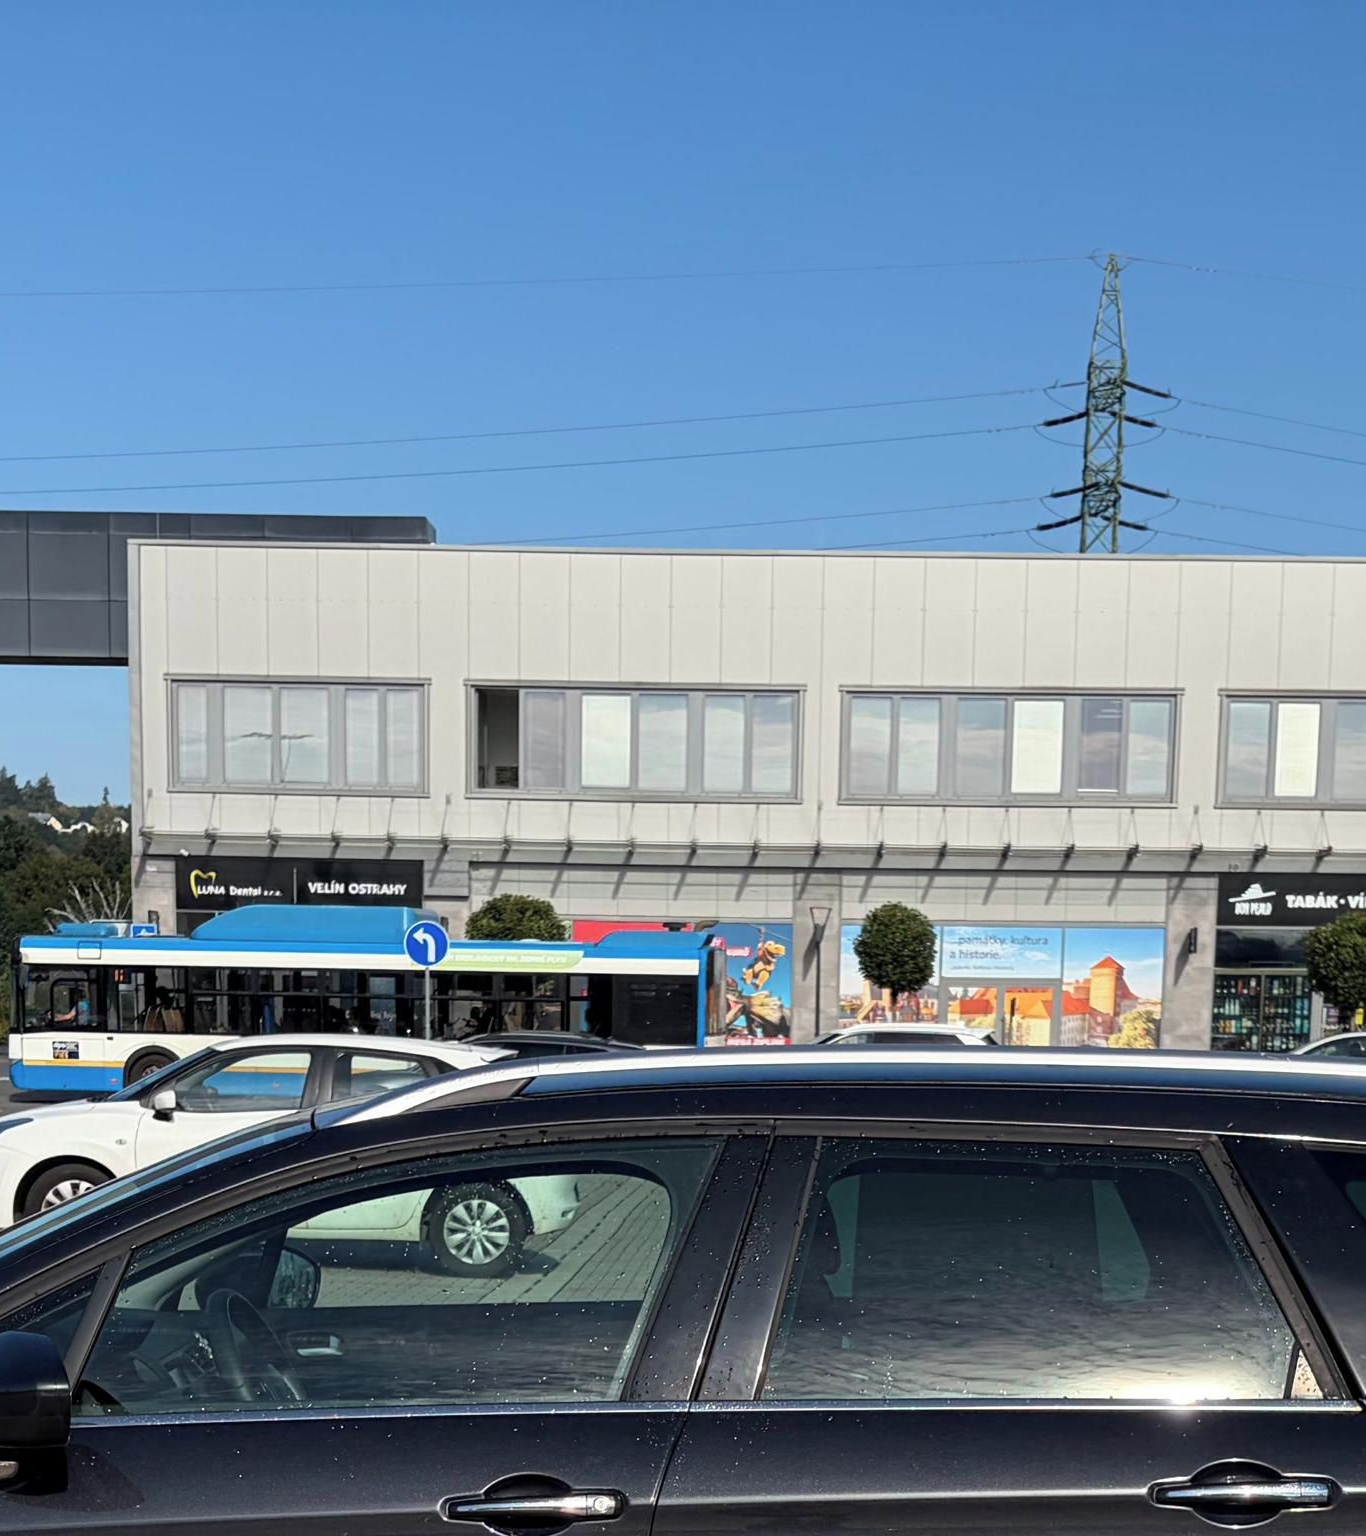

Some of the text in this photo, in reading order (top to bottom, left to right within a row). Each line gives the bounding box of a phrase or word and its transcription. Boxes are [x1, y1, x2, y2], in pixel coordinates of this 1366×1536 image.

[197, 885, 225, 895] LUNA
[229, 885, 262, 896] Dental
[308, 880, 407, 895] VELÍN OSTRAHY
[1285, 892, 1339, 909] TABÁK
[1010, 936, 1049, 945] kultura
